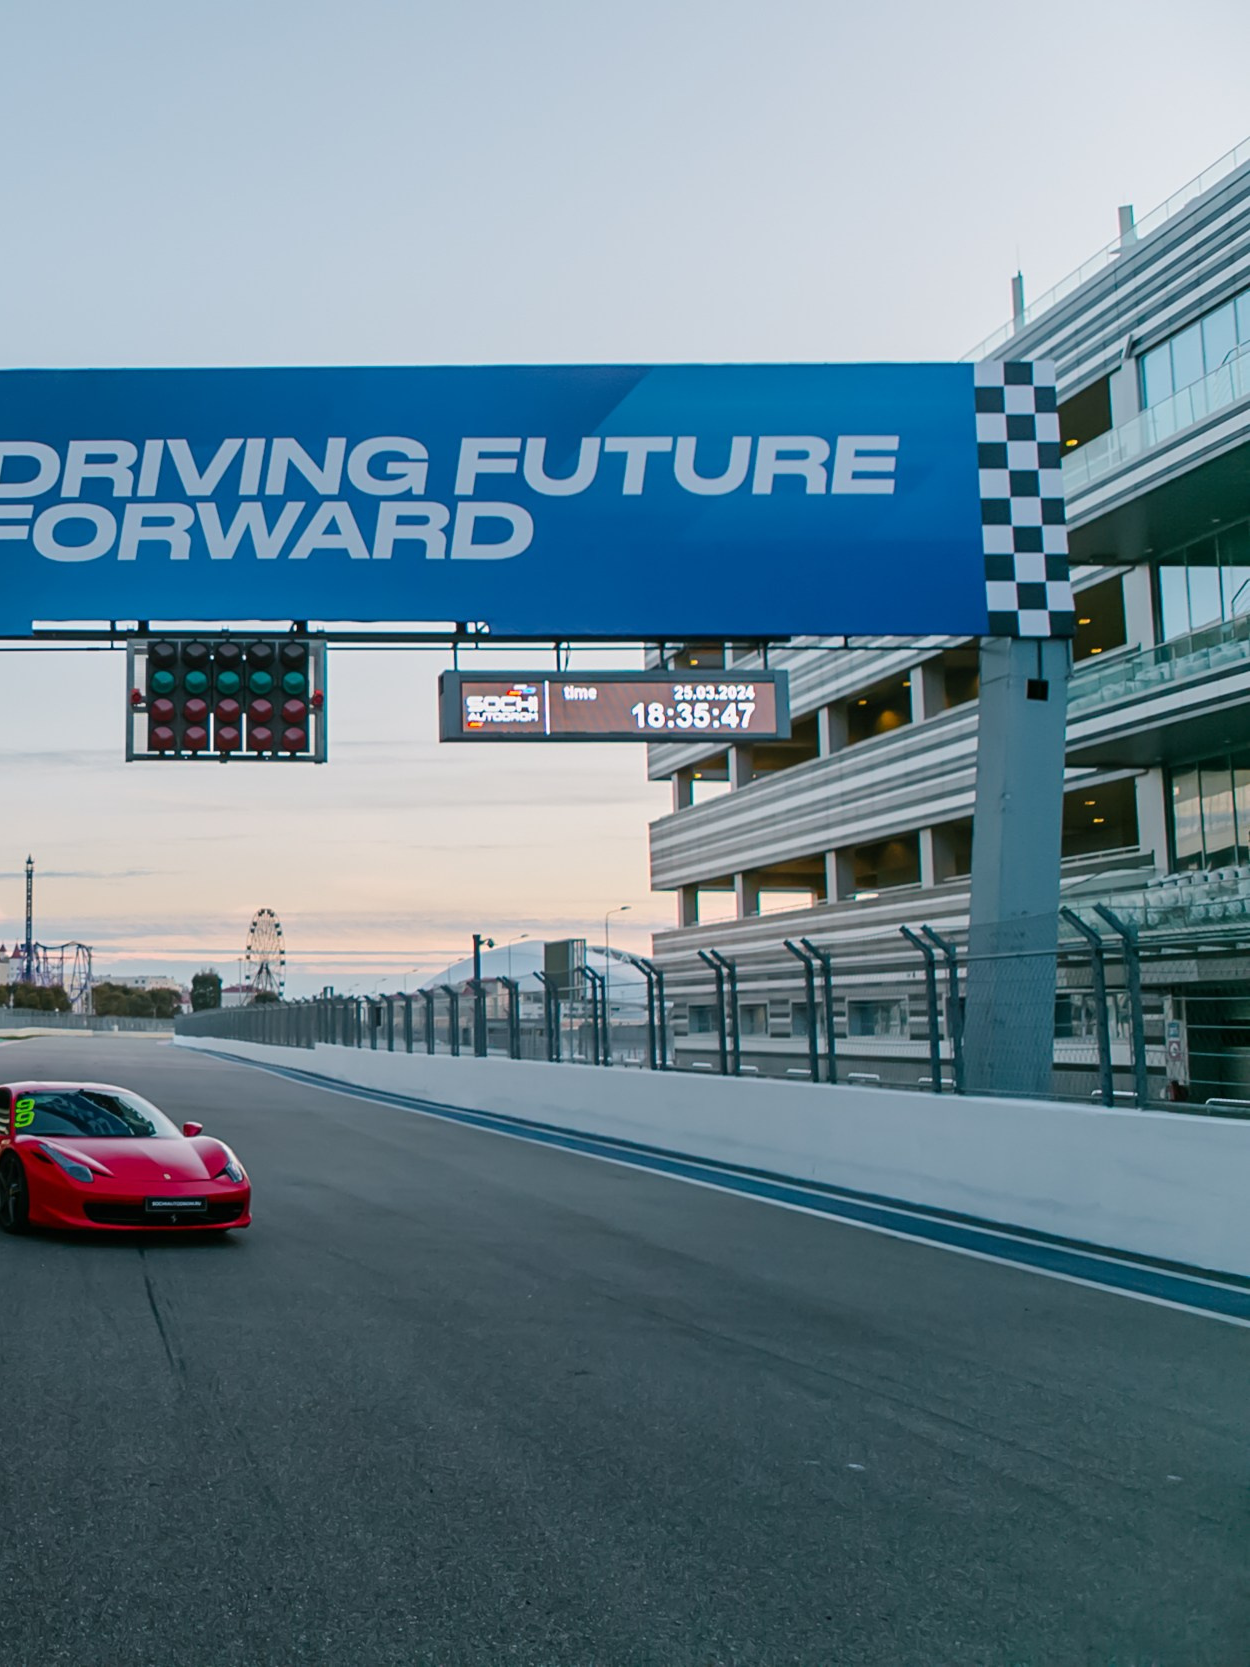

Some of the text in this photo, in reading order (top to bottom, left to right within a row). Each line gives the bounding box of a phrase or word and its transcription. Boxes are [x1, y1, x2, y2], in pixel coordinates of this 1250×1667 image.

[454, 435, 900, 495] FUTURE
[563, 684, 756, 701] time 25.03.2024
[466, 696, 539, 713] SOCHI
[467, 712, 539, 722] AUTODROM
[632, 702, 756, 729] 18:35:47
